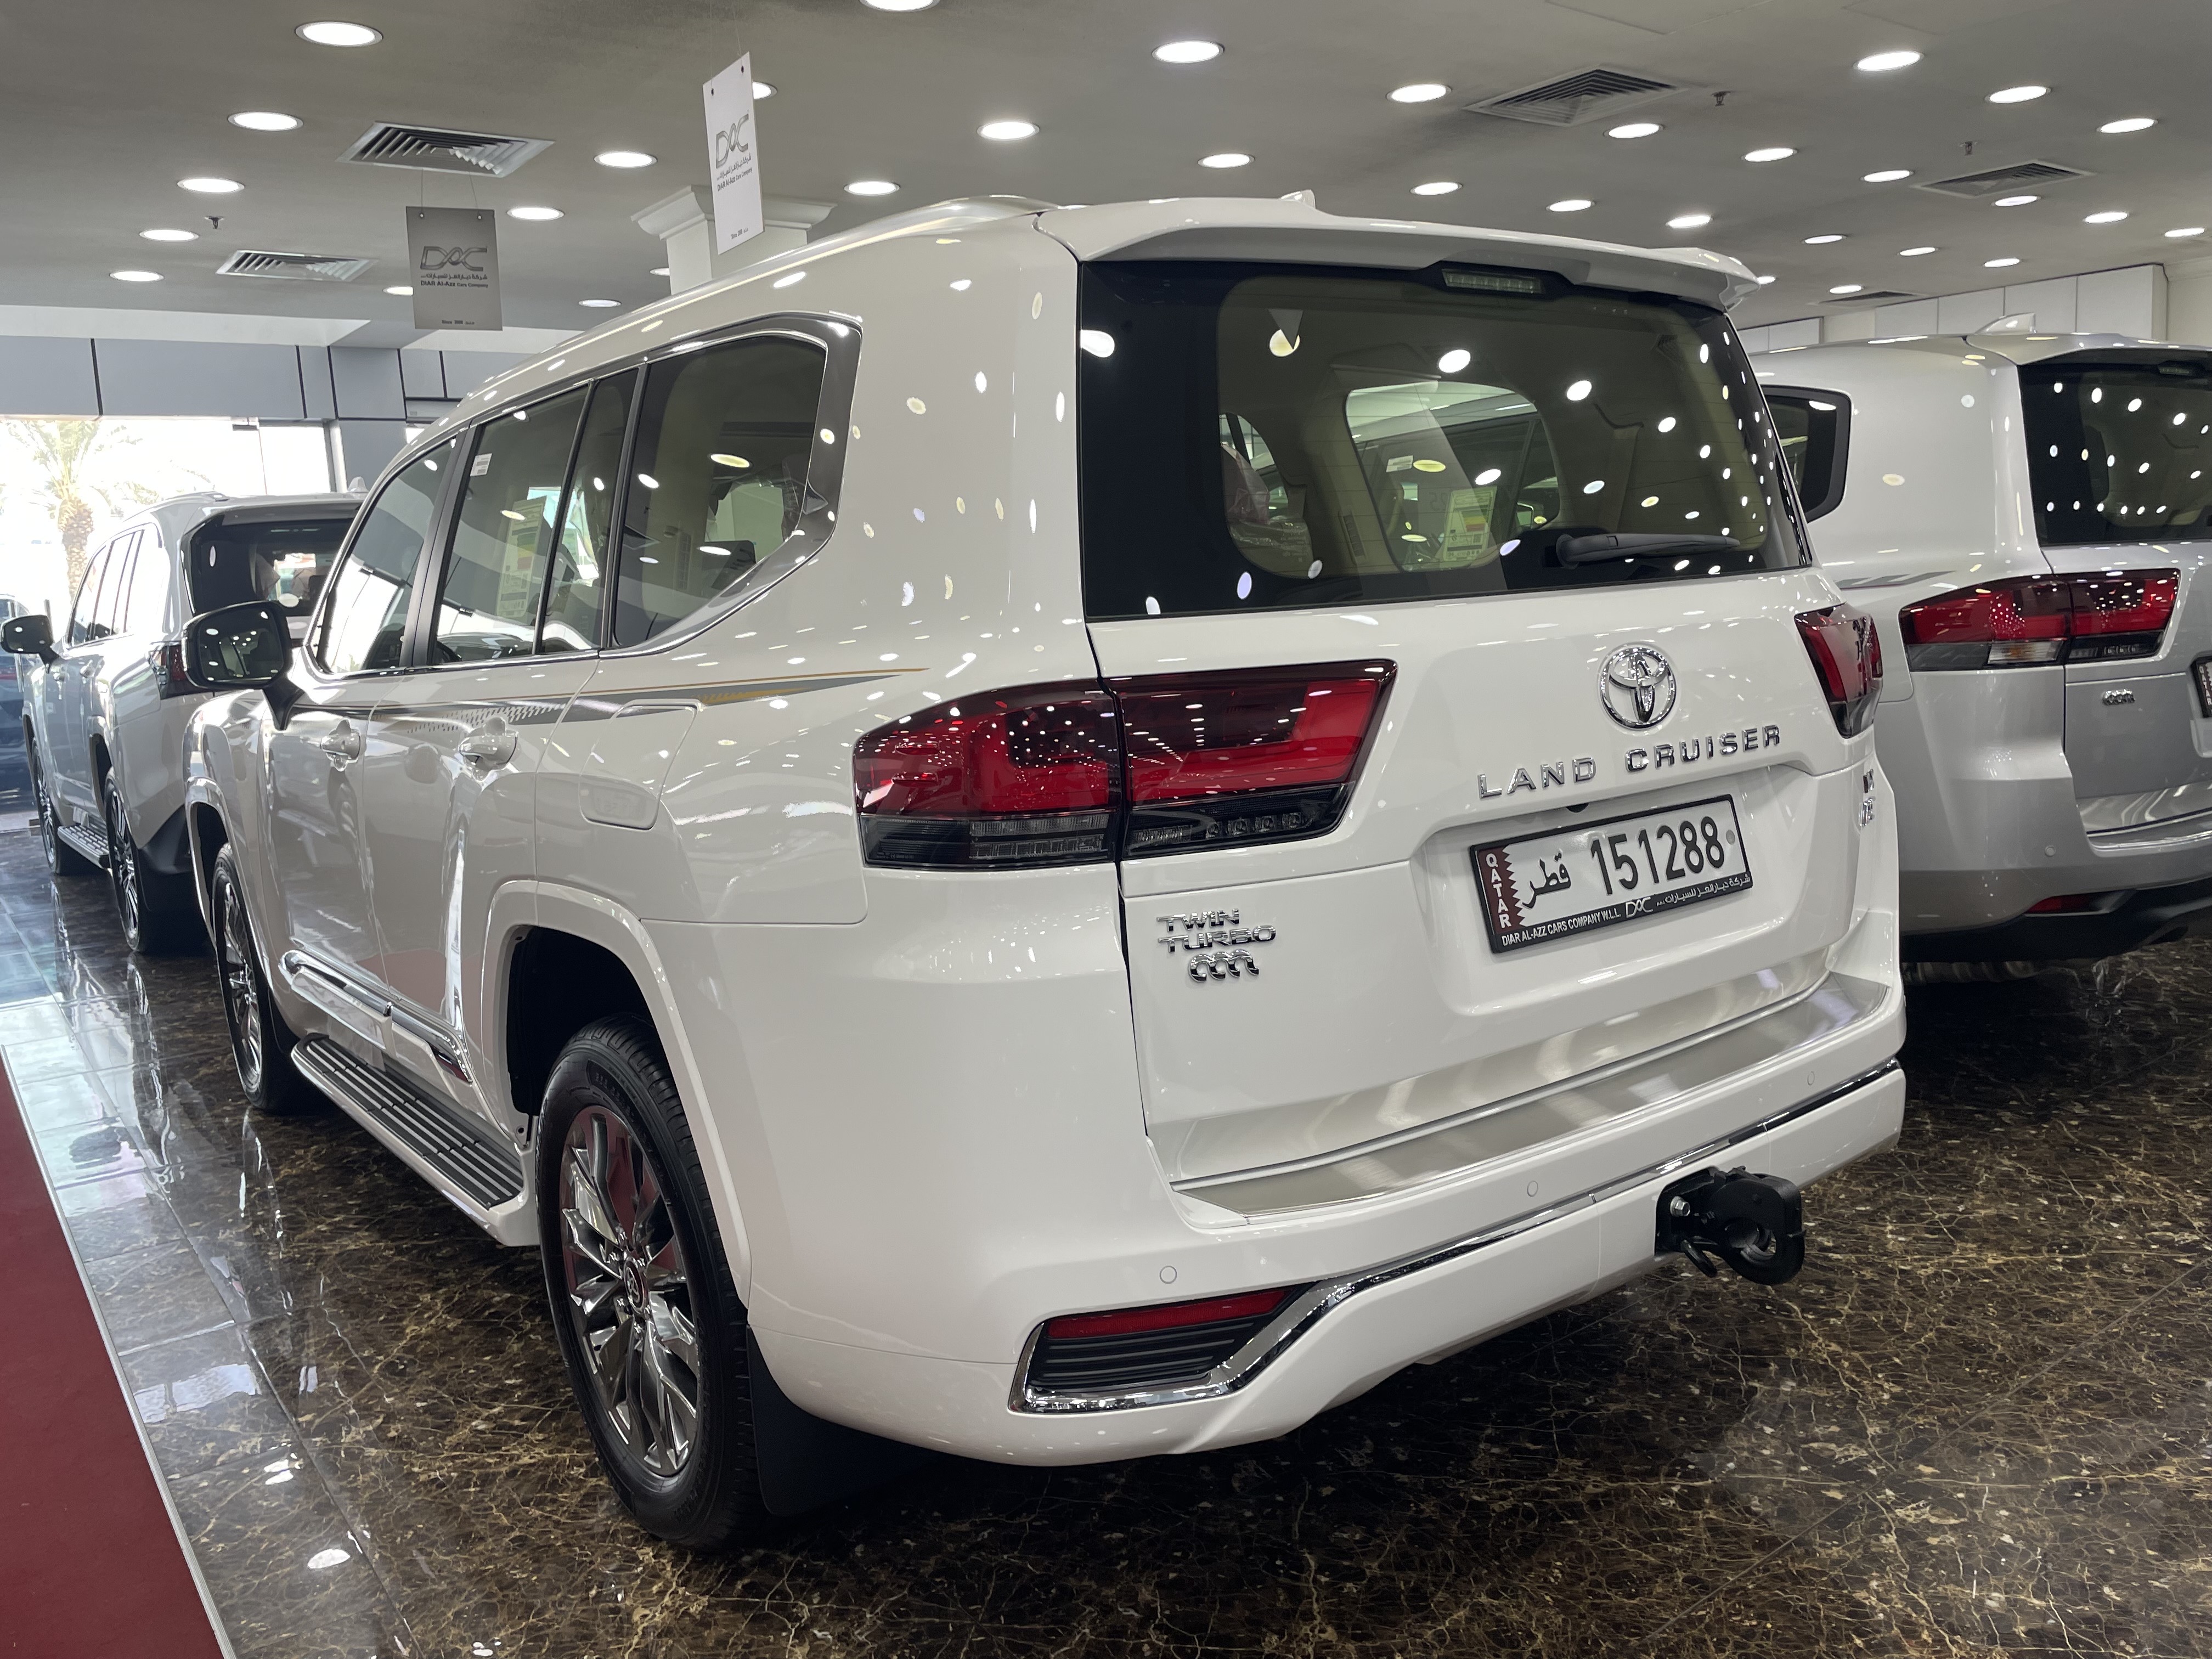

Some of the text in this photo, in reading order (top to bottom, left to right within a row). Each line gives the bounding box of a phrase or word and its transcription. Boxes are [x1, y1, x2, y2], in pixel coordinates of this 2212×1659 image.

[1477, 724, 1781, 799] LAND CRUISER
[1590, 816, 1725, 895] 151288
[1486, 853, 1512, 928] QATAR
[1522, 851, 1571, 909] قطر
[1664, 888, 1696, 904] للسيارات
[1729, 873, 1751, 887] شركة
[1156, 908, 1240, 932] TWIN
[1502, 932, 1521, 946] DIAR
[1522, 926, 1547, 942] AL-AZZ
[1547, 921, 1568, 935] CARS
[1568, 912, 1601, 929] COMPANY
[1158, 924, 1277, 952] TURBO
